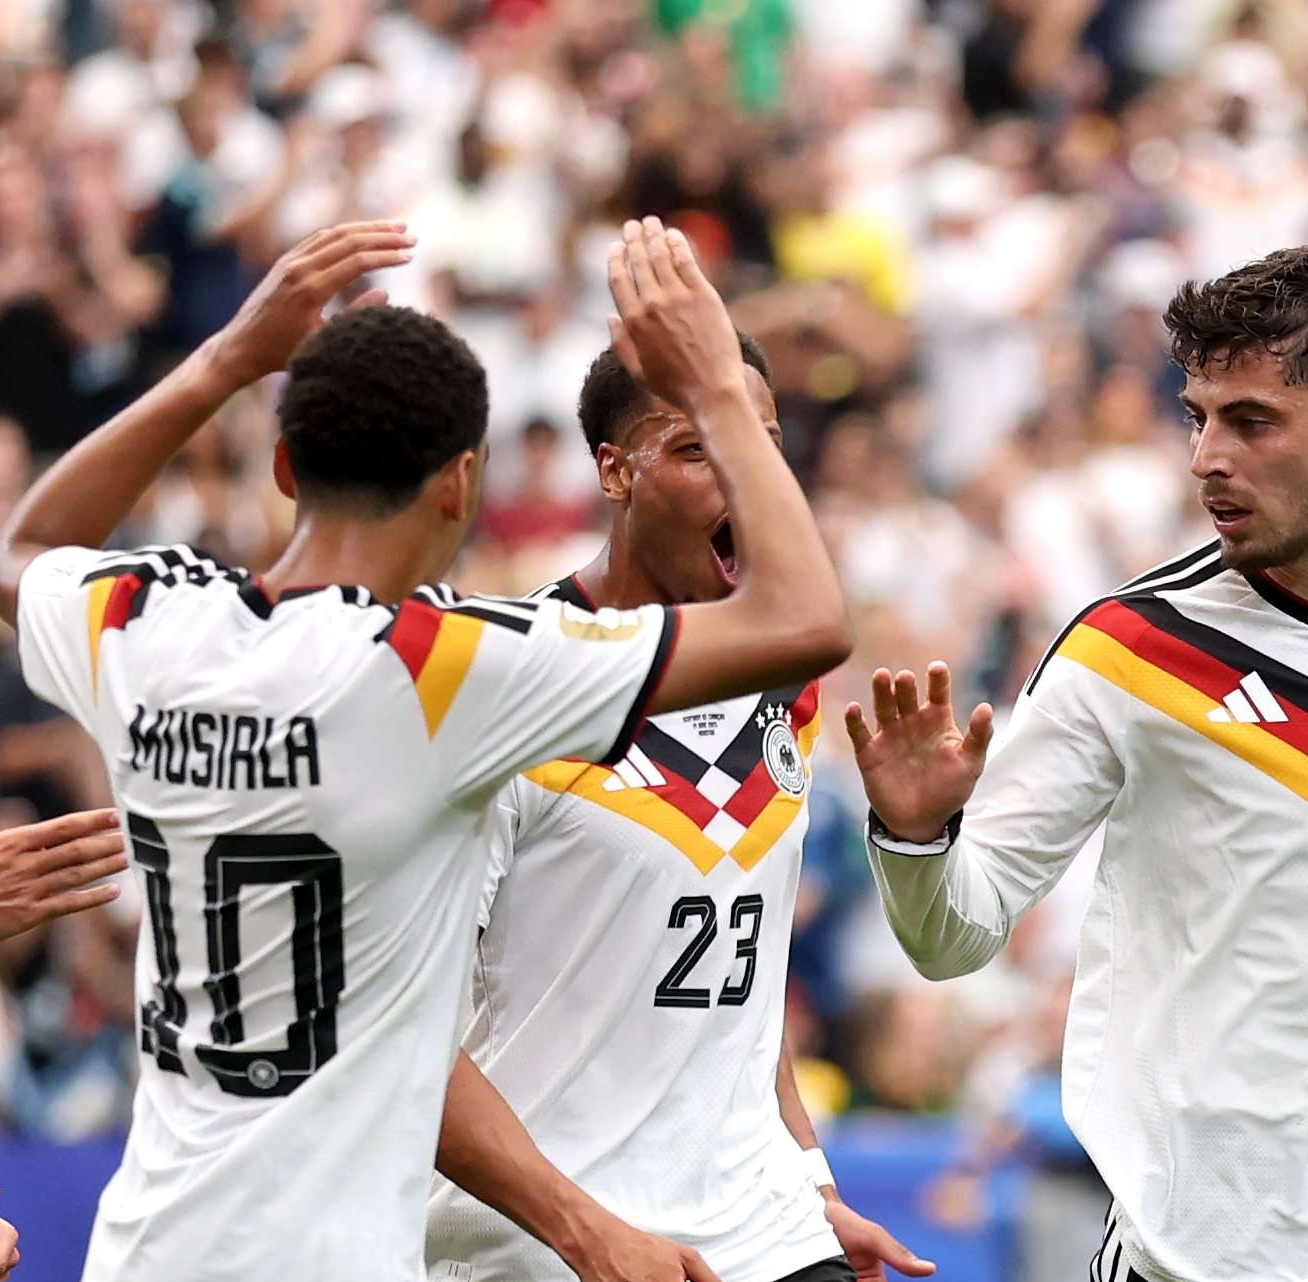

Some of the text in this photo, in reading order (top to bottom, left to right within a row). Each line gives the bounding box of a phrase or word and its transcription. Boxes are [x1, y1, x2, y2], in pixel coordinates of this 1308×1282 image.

[129, 703, 321, 790] MUSIALA
[127, 811, 345, 1097] 10
[653, 893, 764, 1009] 23
